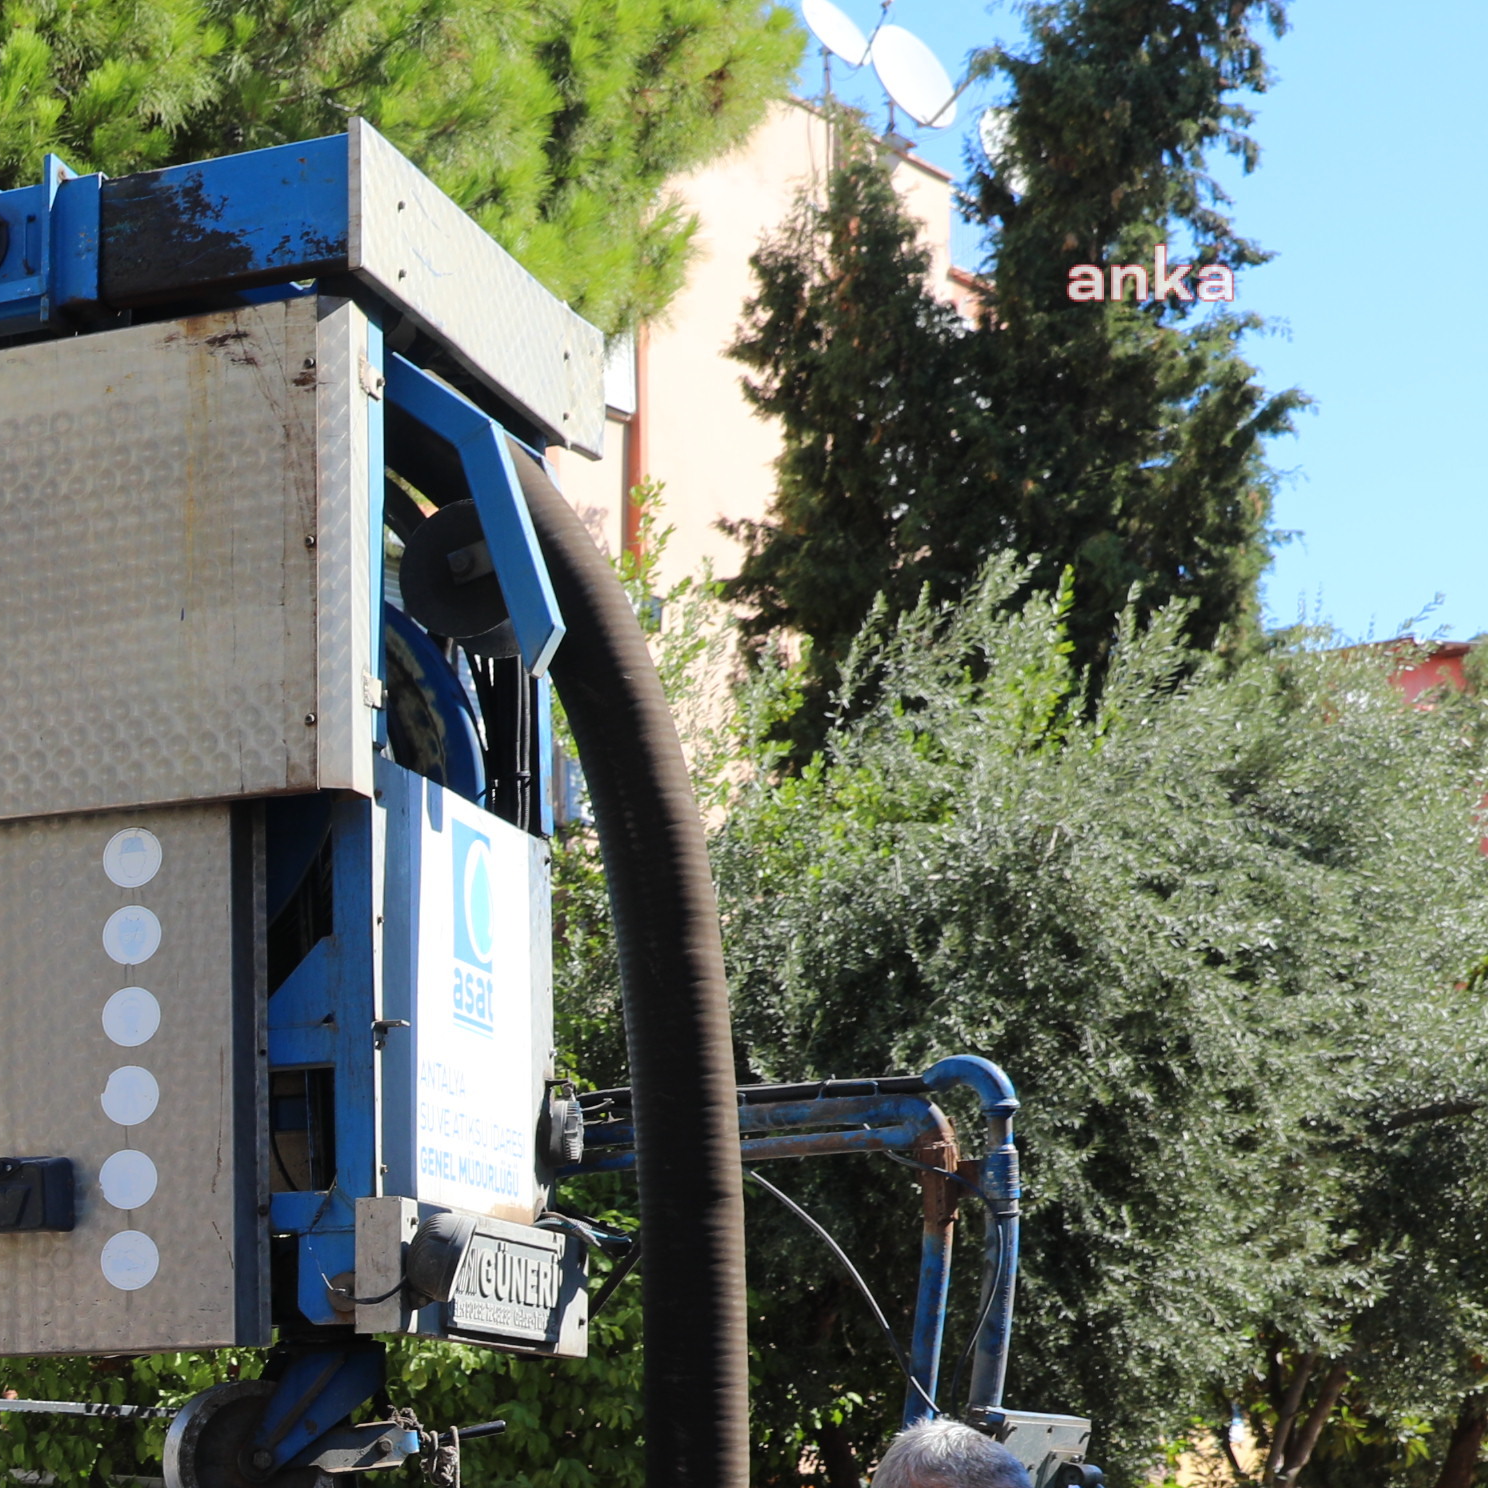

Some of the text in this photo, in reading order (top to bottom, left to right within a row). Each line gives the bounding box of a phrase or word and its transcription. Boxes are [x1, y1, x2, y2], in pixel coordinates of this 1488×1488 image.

[453, 966, 494, 1023] asat
[420, 1058, 466, 1098] ANTALYA
[420, 1102, 435, 1132] SU
[437, 1107, 451, 1138] VE
[453, 1111, 489, 1148] ATIKSU
[420, 1145, 520, 1198] GENEL MÜDÜRLÜĞÜ
